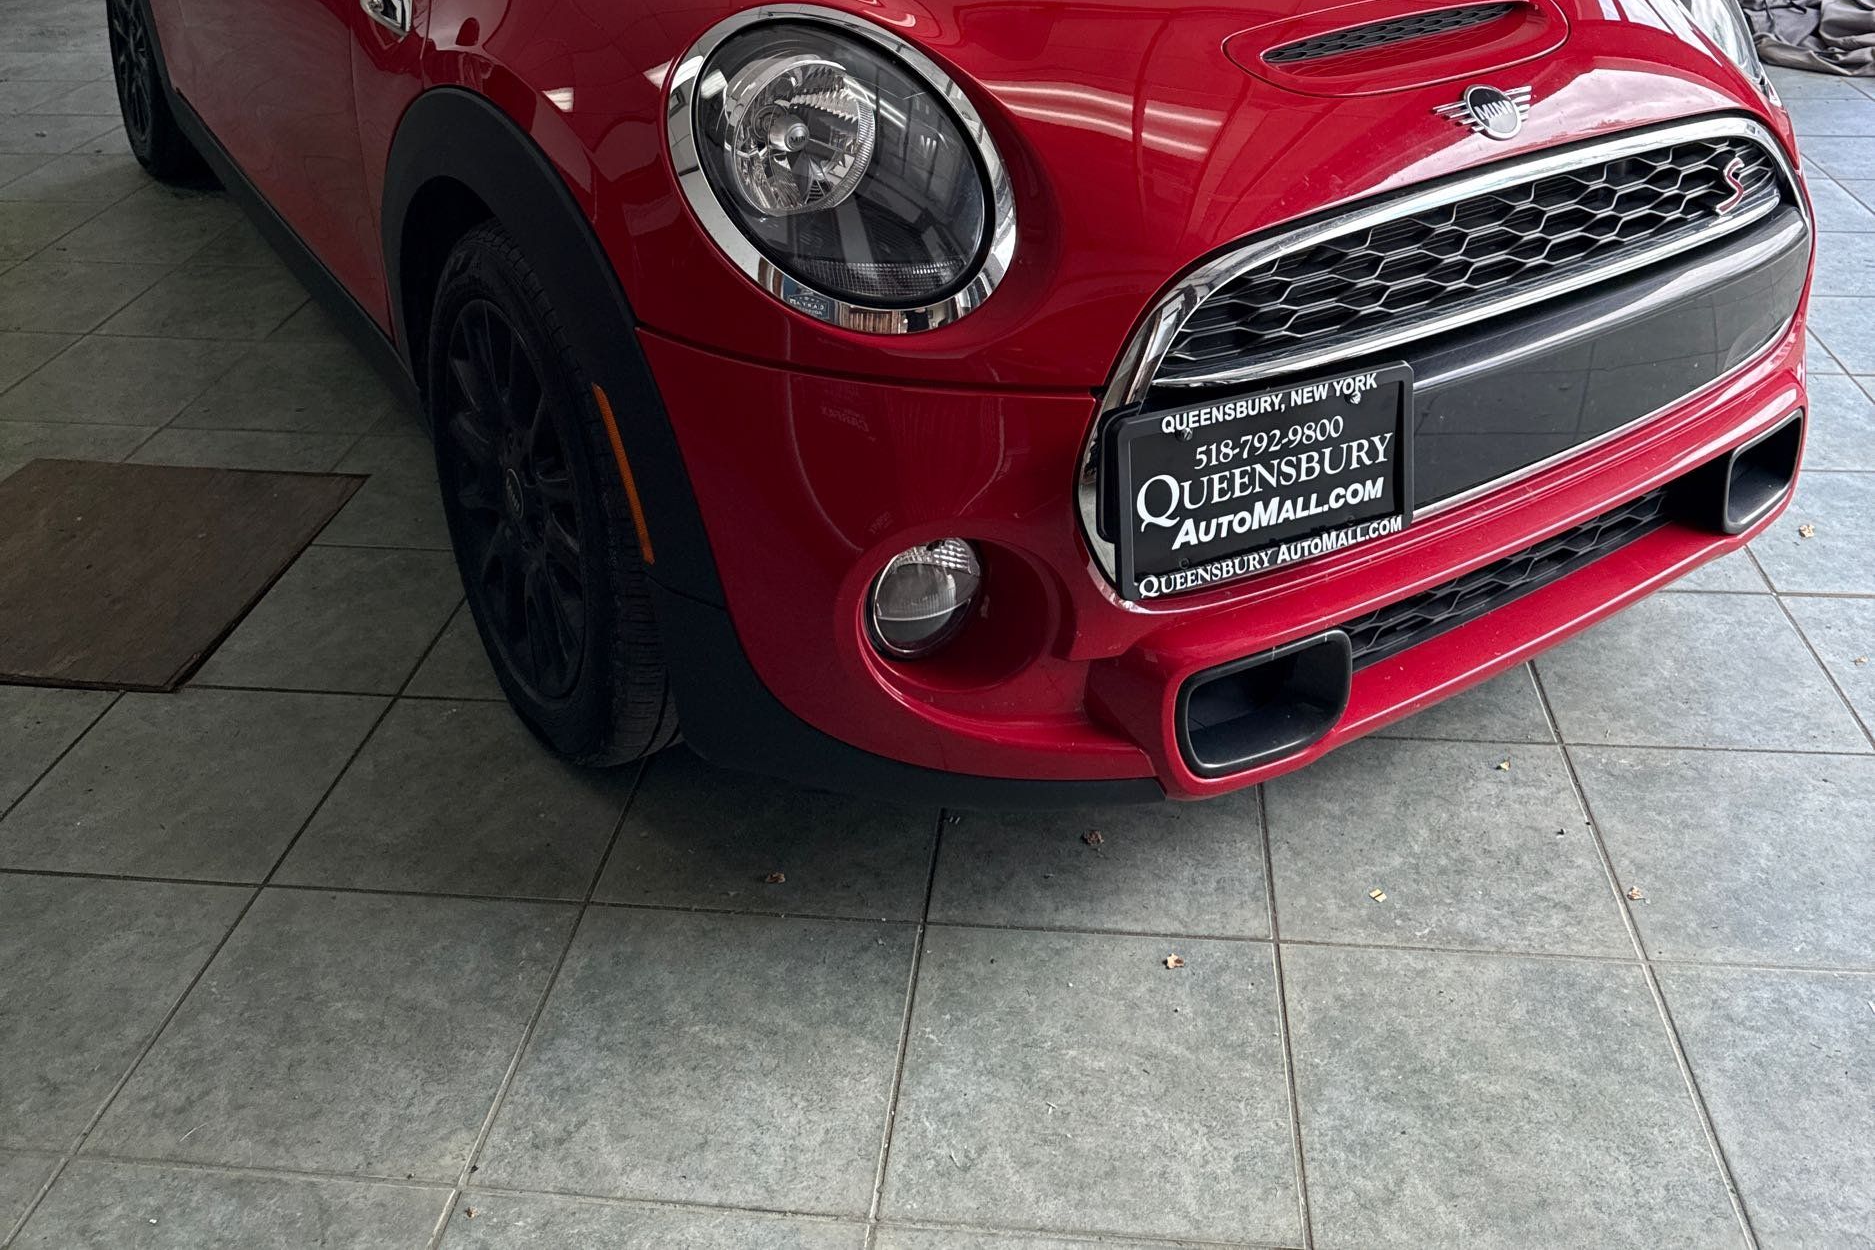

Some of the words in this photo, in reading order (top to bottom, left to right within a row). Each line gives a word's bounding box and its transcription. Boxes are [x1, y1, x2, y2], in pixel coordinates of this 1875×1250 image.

[1474, 100, 1514, 121] MINI
[1716, 157, 1745, 215] S
[1161, 393, 1285, 433] QUEENSBURY,
[1290, 383, 1328, 407] NEW
[1333, 372, 1377, 397] YORK
[1194, 415, 1344, 470] 518-792-9800
[1136, 432, 1393, 532] QUEENSBURY
[1139, 550, 1272, 599] QUEENSBURY
